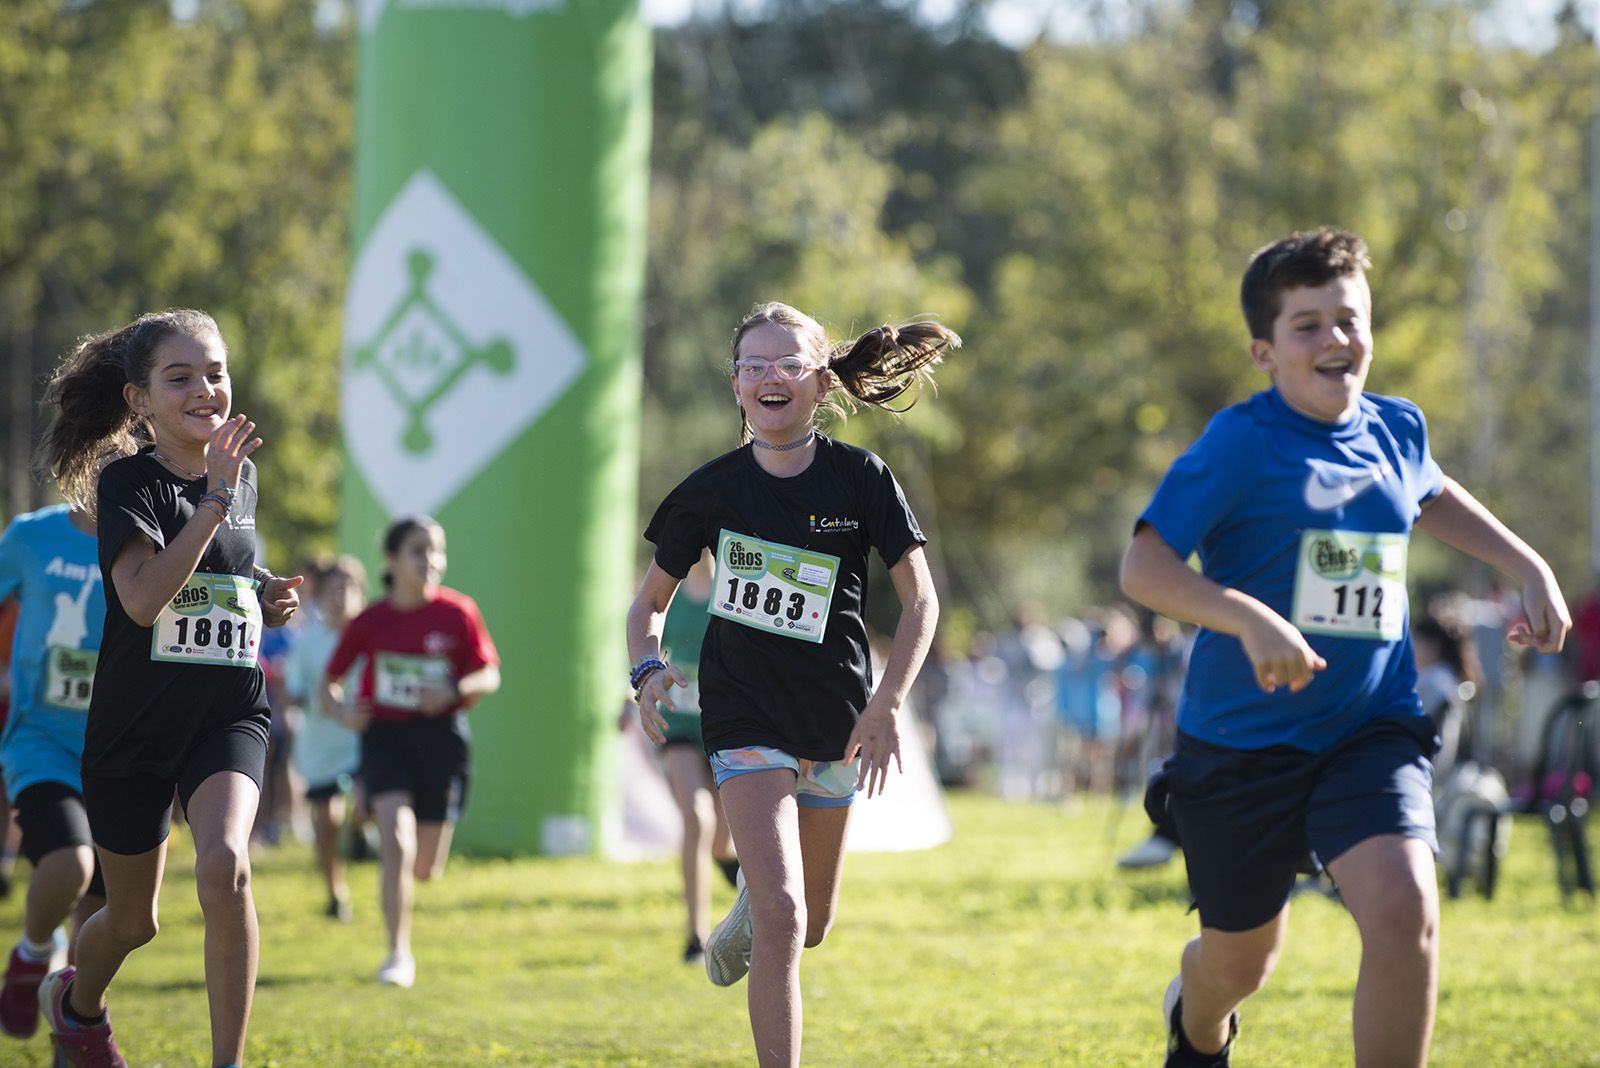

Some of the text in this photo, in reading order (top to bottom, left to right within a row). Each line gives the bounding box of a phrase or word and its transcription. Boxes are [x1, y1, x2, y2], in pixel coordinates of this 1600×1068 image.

[730, 551, 763, 567] CROS
[1316, 548, 1358, 568] CROS
[172, 586, 209, 605] CROS
[727, 577, 806, 621] 1883
[1334, 585, 1384, 618] 112
[174, 616, 248, 650] 1881
[63, 679, 91, 698] 19
